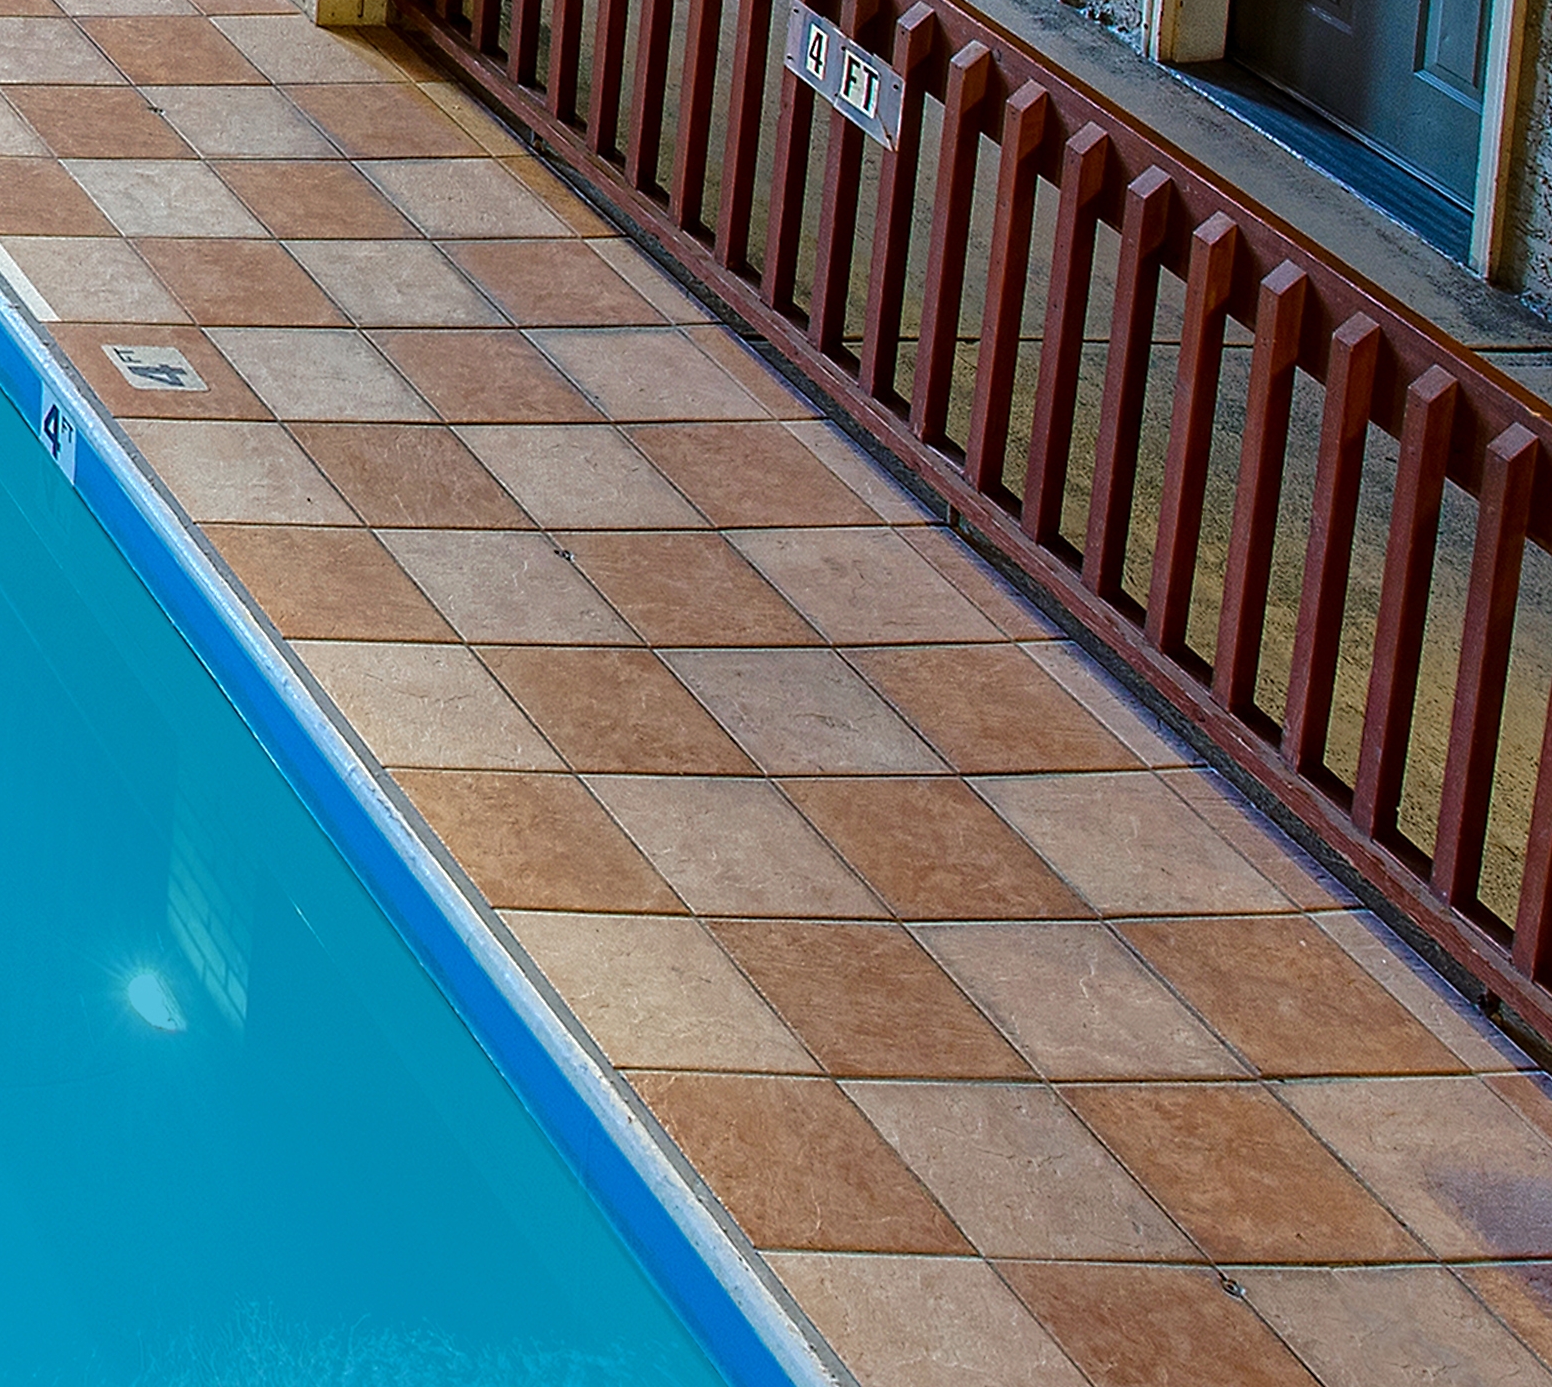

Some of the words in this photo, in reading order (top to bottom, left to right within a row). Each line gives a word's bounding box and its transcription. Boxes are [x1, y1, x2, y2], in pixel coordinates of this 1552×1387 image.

[809, 32, 823, 73] 4
[844, 58, 879, 112] FT
[113, 347, 142, 363] FT
[127, 364, 188, 387] 4
[42, 403, 62, 460] 4
[61, 420, 74, 444] FT
